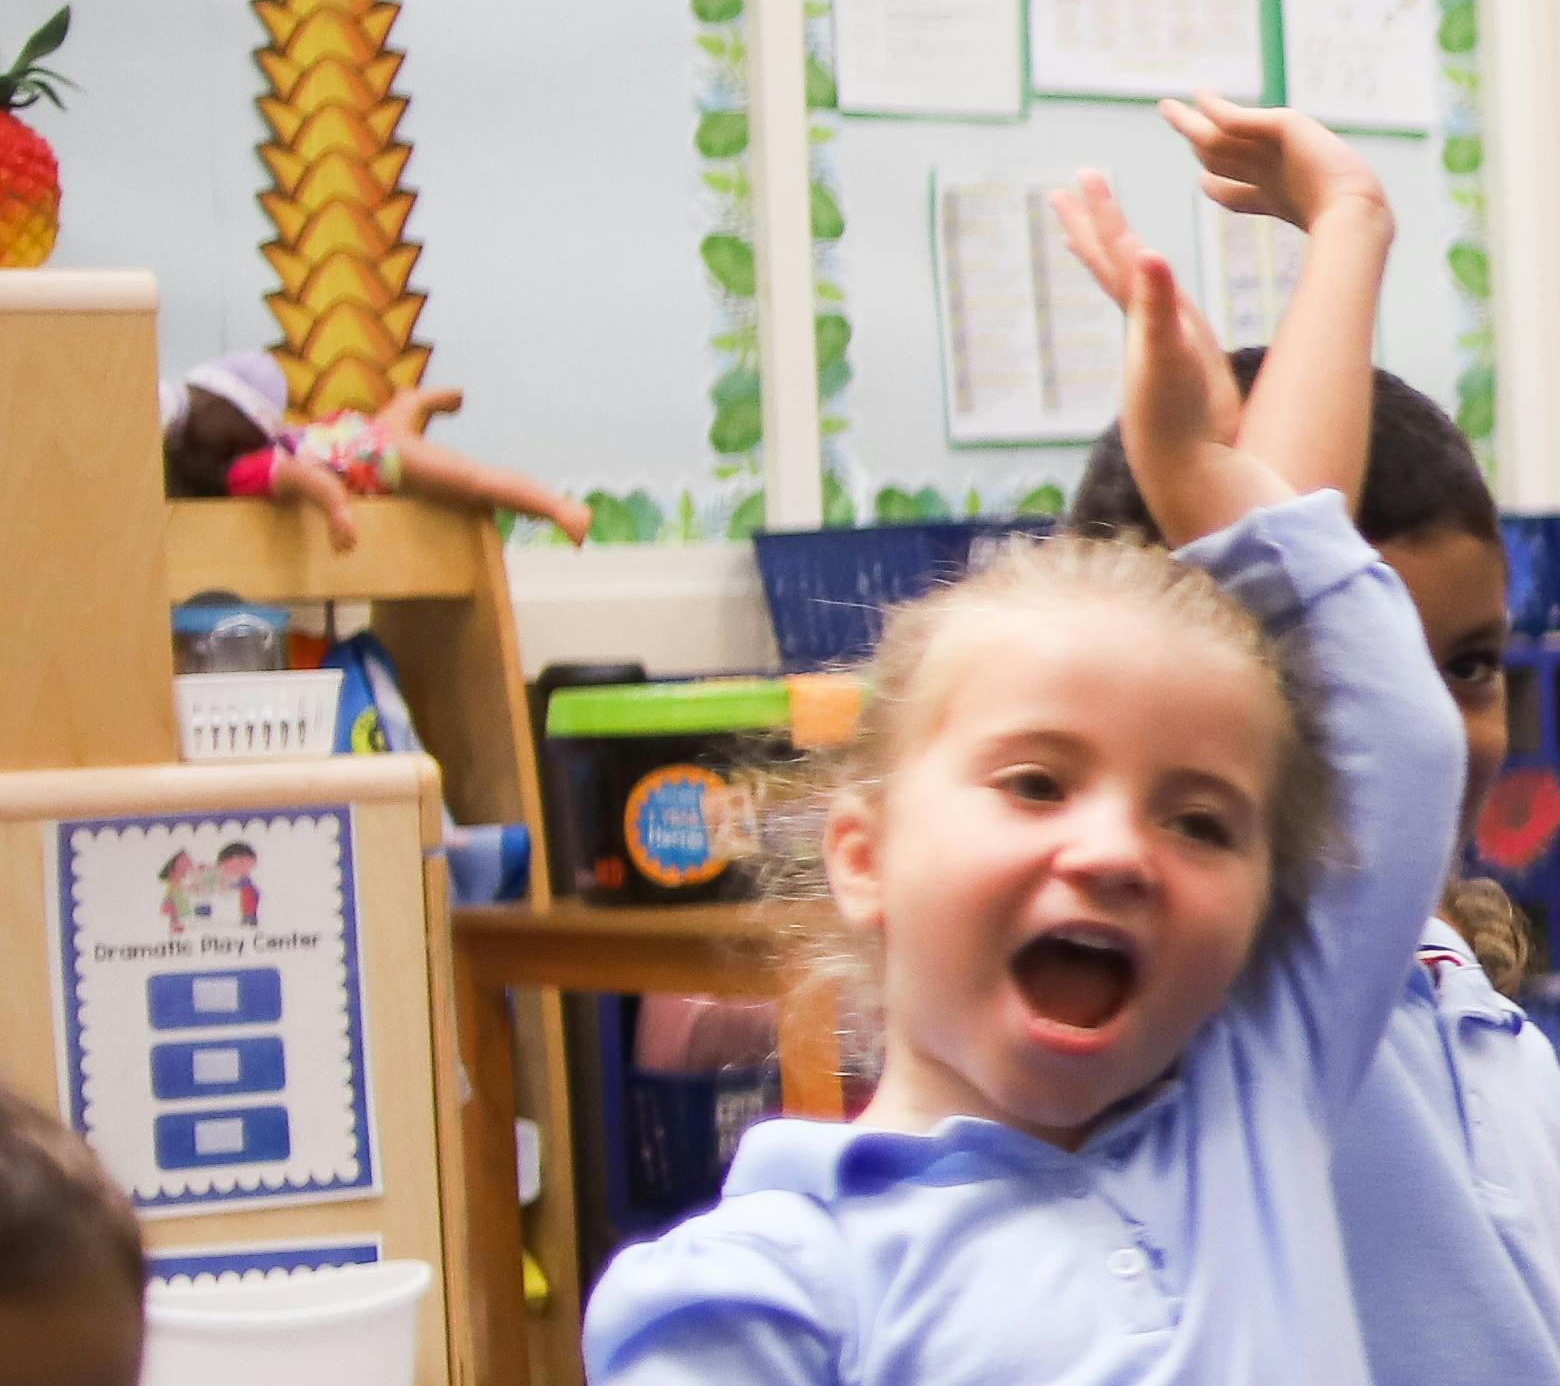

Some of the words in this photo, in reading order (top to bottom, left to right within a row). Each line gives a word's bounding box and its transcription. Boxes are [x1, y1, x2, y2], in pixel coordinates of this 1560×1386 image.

[93, 937, 193, 963] Dramatic
[199, 932, 245, 958] Play
[253, 930, 321, 953] Center
